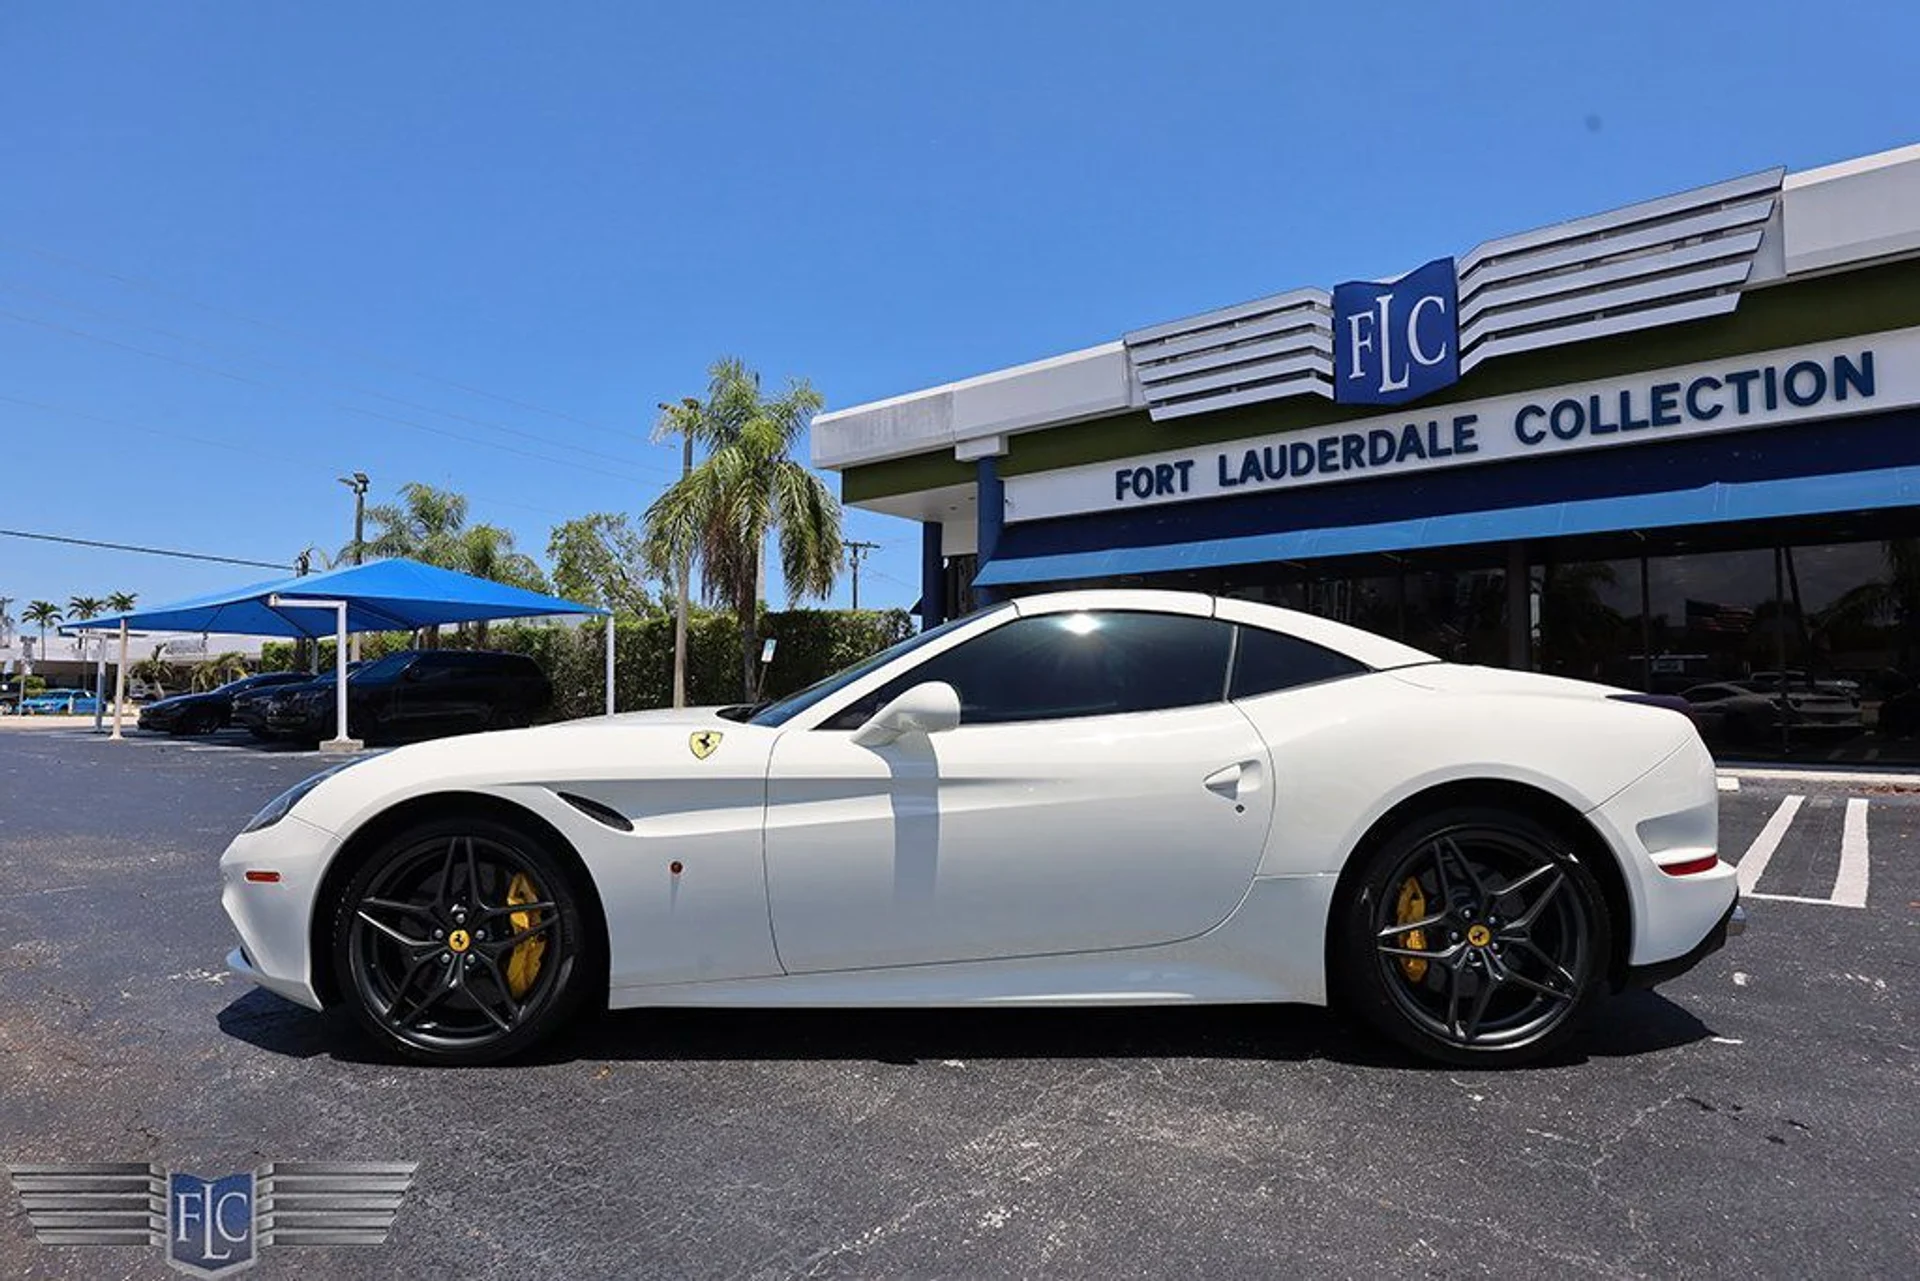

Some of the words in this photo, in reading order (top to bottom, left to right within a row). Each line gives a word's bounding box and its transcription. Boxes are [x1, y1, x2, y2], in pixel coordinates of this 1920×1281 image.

[1347, 294, 1447, 393] FLC
[1115, 460, 1194, 500] FORT
[1218, 414, 1479, 487] LAUDERDALE
[1514, 351, 1876, 445] COLLECTION
